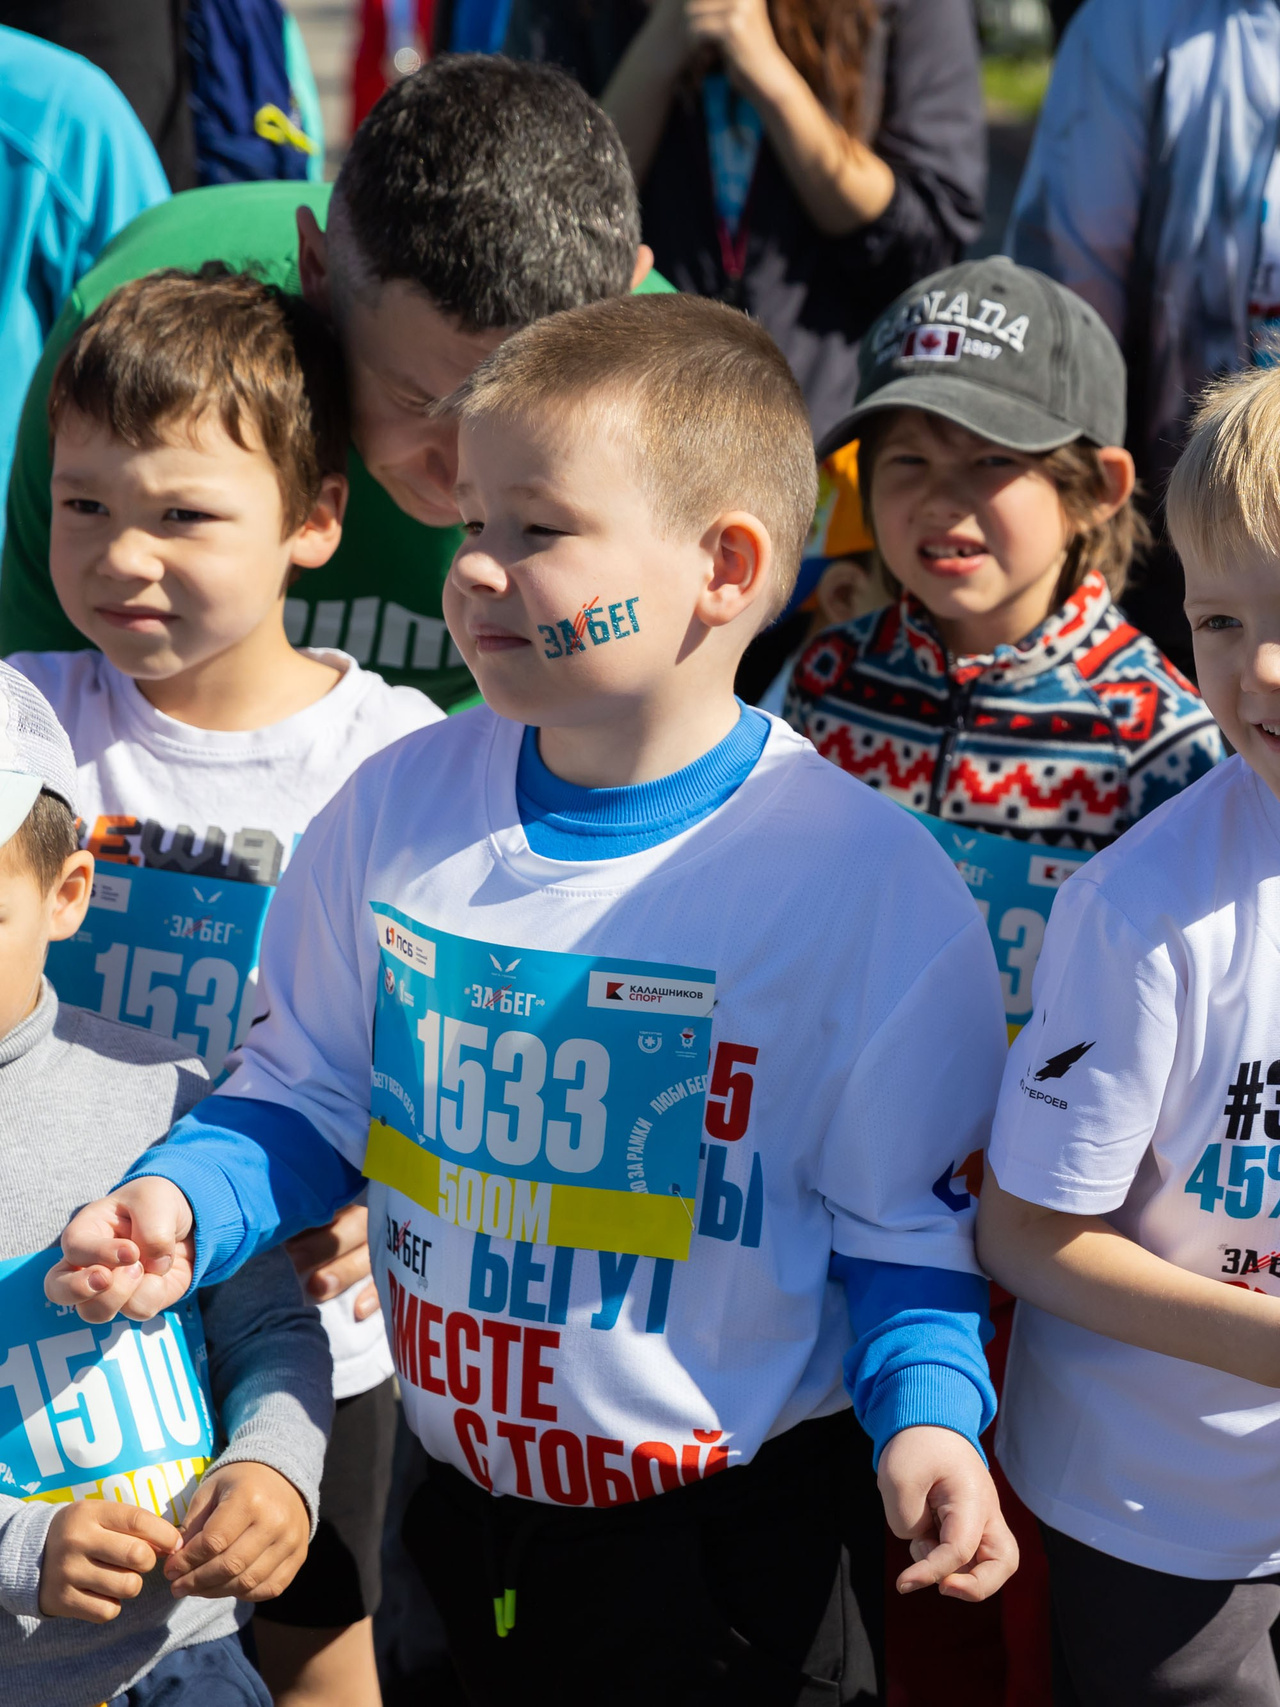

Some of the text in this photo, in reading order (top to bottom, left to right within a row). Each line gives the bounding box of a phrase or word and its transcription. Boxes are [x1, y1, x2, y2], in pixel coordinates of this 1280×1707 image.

[538, 597, 640, 660] ЗАБЕГ
[396, 934, 413, 958] ПСБ
[95, 942, 258, 1080] 153
[629, 984, 704, 1000] КАЛАШНИКОВ
[629, 993, 663, 1003] СПОРТ
[417, 1009, 611, 1174] 1533
[626, 1116, 653, 1161] РАМКИ
[437, 1158, 552, 1245] 500М
[0, 1314, 201, 1478] 1510
